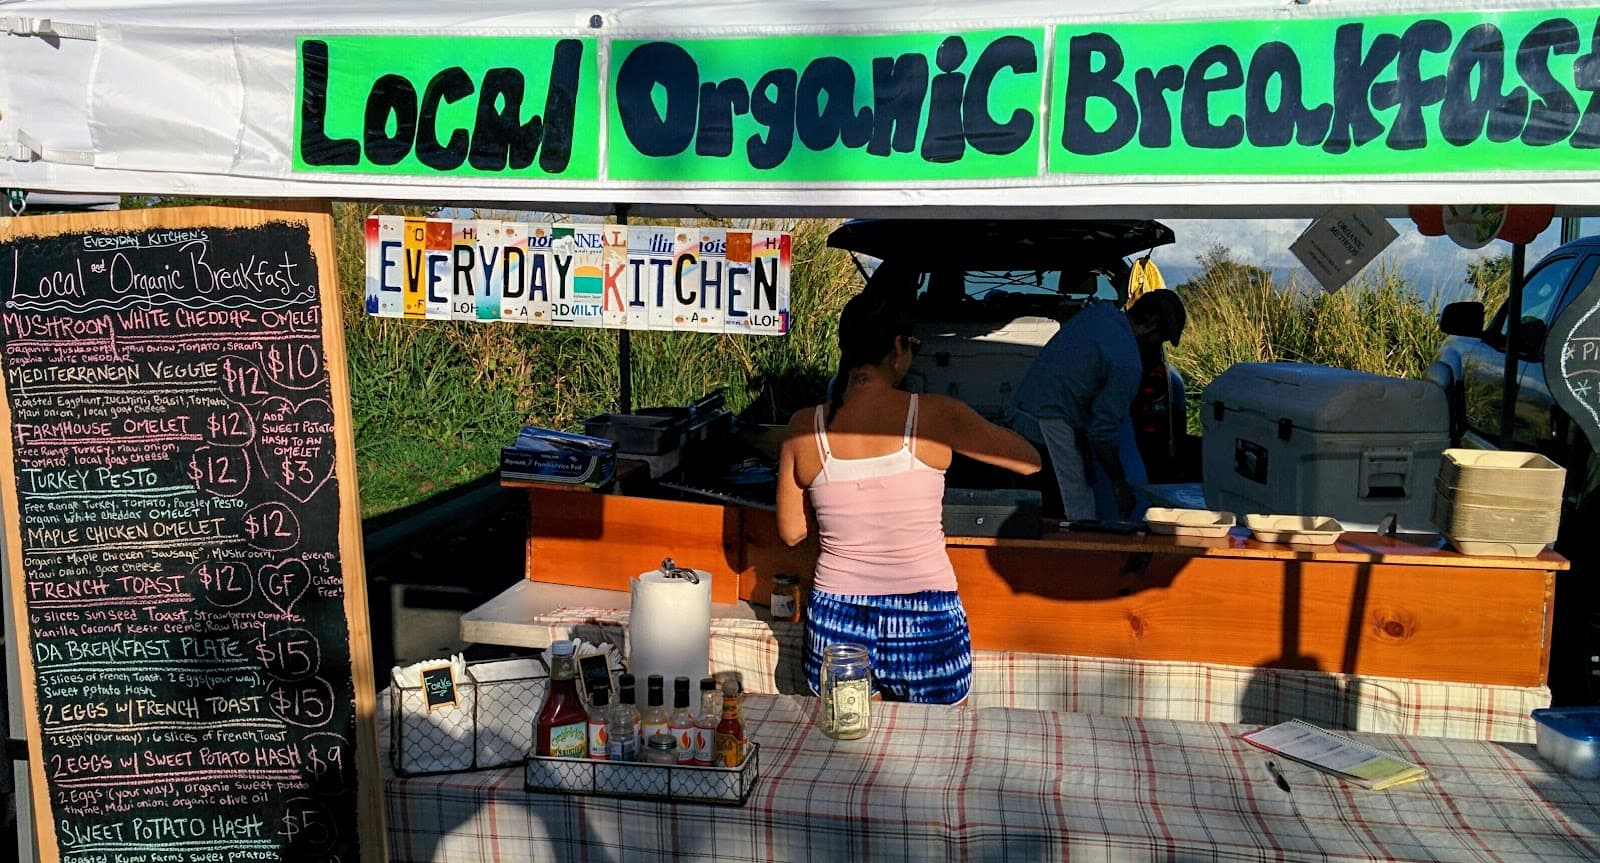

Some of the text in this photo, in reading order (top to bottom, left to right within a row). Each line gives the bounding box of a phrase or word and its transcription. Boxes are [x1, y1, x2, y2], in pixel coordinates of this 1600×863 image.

[301, 39, 583, 174] Local
[616, 36, 1038, 170] Organic
[83, 228, 209, 249] EVERYDAY KITCHEN'S
[12, 249, 85, 300] Local
[110, 252, 185, 304] Organic
[180, 241, 300, 296] Breakfast
[380, 240, 779, 318] EVERYDAY KITCHEN
[3, 305, 321, 341] MUSHROOM WHITE CHEDDAR OMELET
[268, 343, 318, 381] $10
[9, 358, 269, 397] MEDITERRANEAN VEGGIE $12
[83, 408, 108, 418] local
[262, 413, 284, 422] ADD
[16, 411, 248, 445] FARMHOUSE OMELET $12
[261, 423, 300, 434] SWEET
[261, 436, 322, 446] HASH TO AN
[74, 455, 102, 465] local
[273, 447, 321, 458] OMELET
[21, 453, 237, 493] TURKEY PESTO $12
[281, 455, 314, 486] $3
[24, 502, 45, 514] Free
[47, 502, 79, 516] Range
[148, 508, 201, 520] OMELET
[27, 509, 292, 548] MAPLE CHICKEN OMELET $12
[24, 557, 63, 570] Organic
[28, 564, 243, 600] FRENCH TOAST $12
[268, 573, 295, 596] GF
[31, 613, 40, 624] 6
[35, 637, 311, 675] DA BREAKFAST PLATE $15
[38, 675, 49, 687] 3
[86, 673, 96, 683] of
[168, 673, 177, 683] 2
[424, 675, 452, 692] Forks
[43, 687, 324, 725] 2 EGGS FRENCH TOAST $15
[202, 729, 214, 741] of
[50, 753, 68, 779] 2
[67, 754, 113, 774] EGGS
[143, 750, 193, 767] SWEET
[199, 746, 250, 768] POTATO
[254, 743, 302, 768] HASH
[305, 743, 344, 782] $9
[58, 791, 69, 805] 2
[251, 791, 269, 803] oil
[61, 819, 124, 847] SWEET
[132, 816, 205, 841] POTATO
[212, 813, 264, 838] HASH
